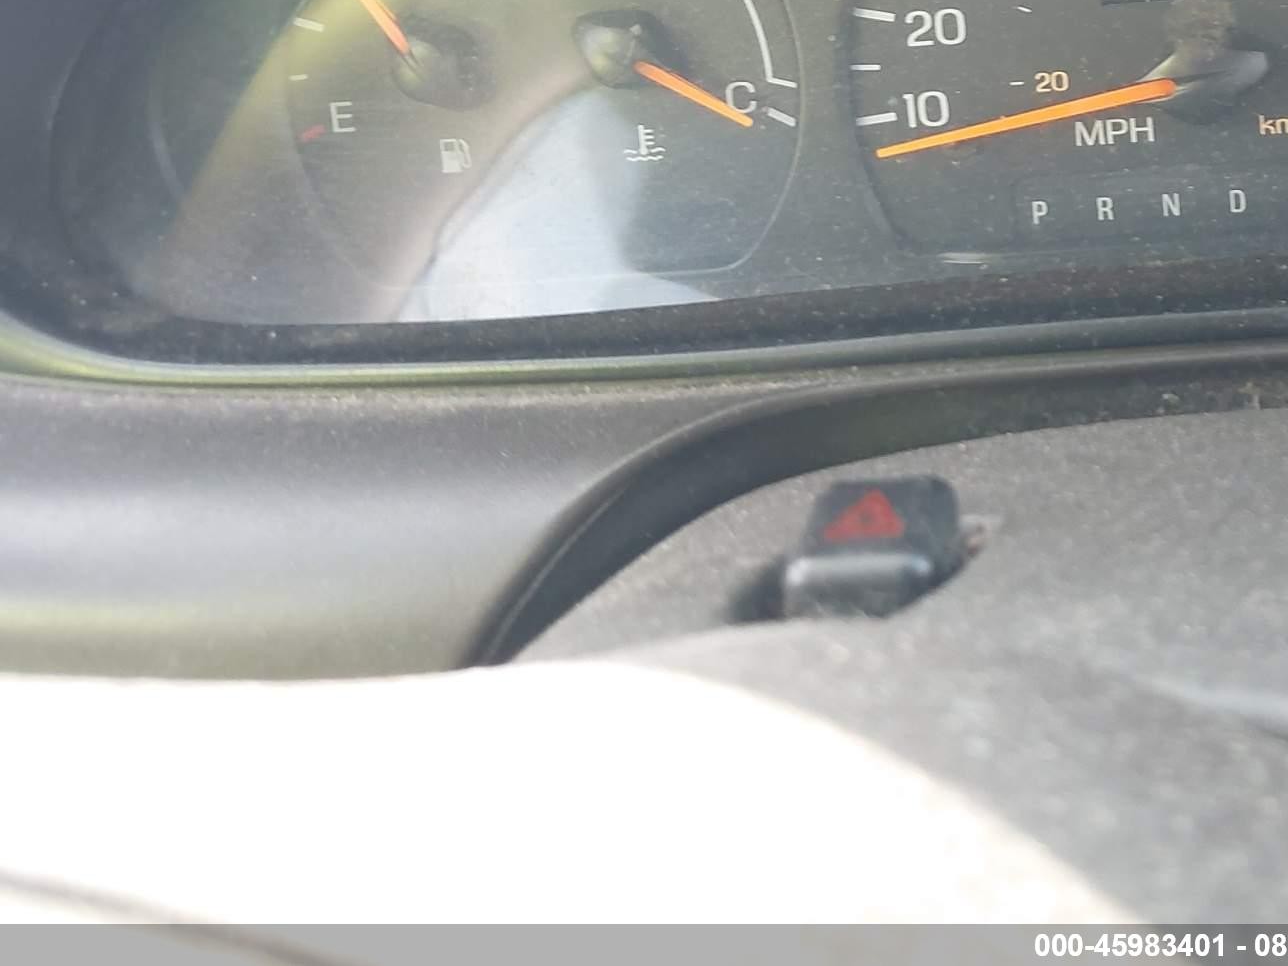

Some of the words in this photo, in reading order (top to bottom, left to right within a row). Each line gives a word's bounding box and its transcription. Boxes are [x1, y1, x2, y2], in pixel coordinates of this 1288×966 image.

[904, 8, 967, 47] 20
[725, 81, 757, 114] C
[1034, 71, 1070, 93] 20
[329, 101, 355, 134] E
[903, 91, 950, 128] 10
[1074, 117, 1157, 148] MPH
[1032, 200, 1049, 225] P
[1097, 197, 1115, 222] R
[1162, 193, 1181, 217] N
[1229, 189, 1247, 215] D
